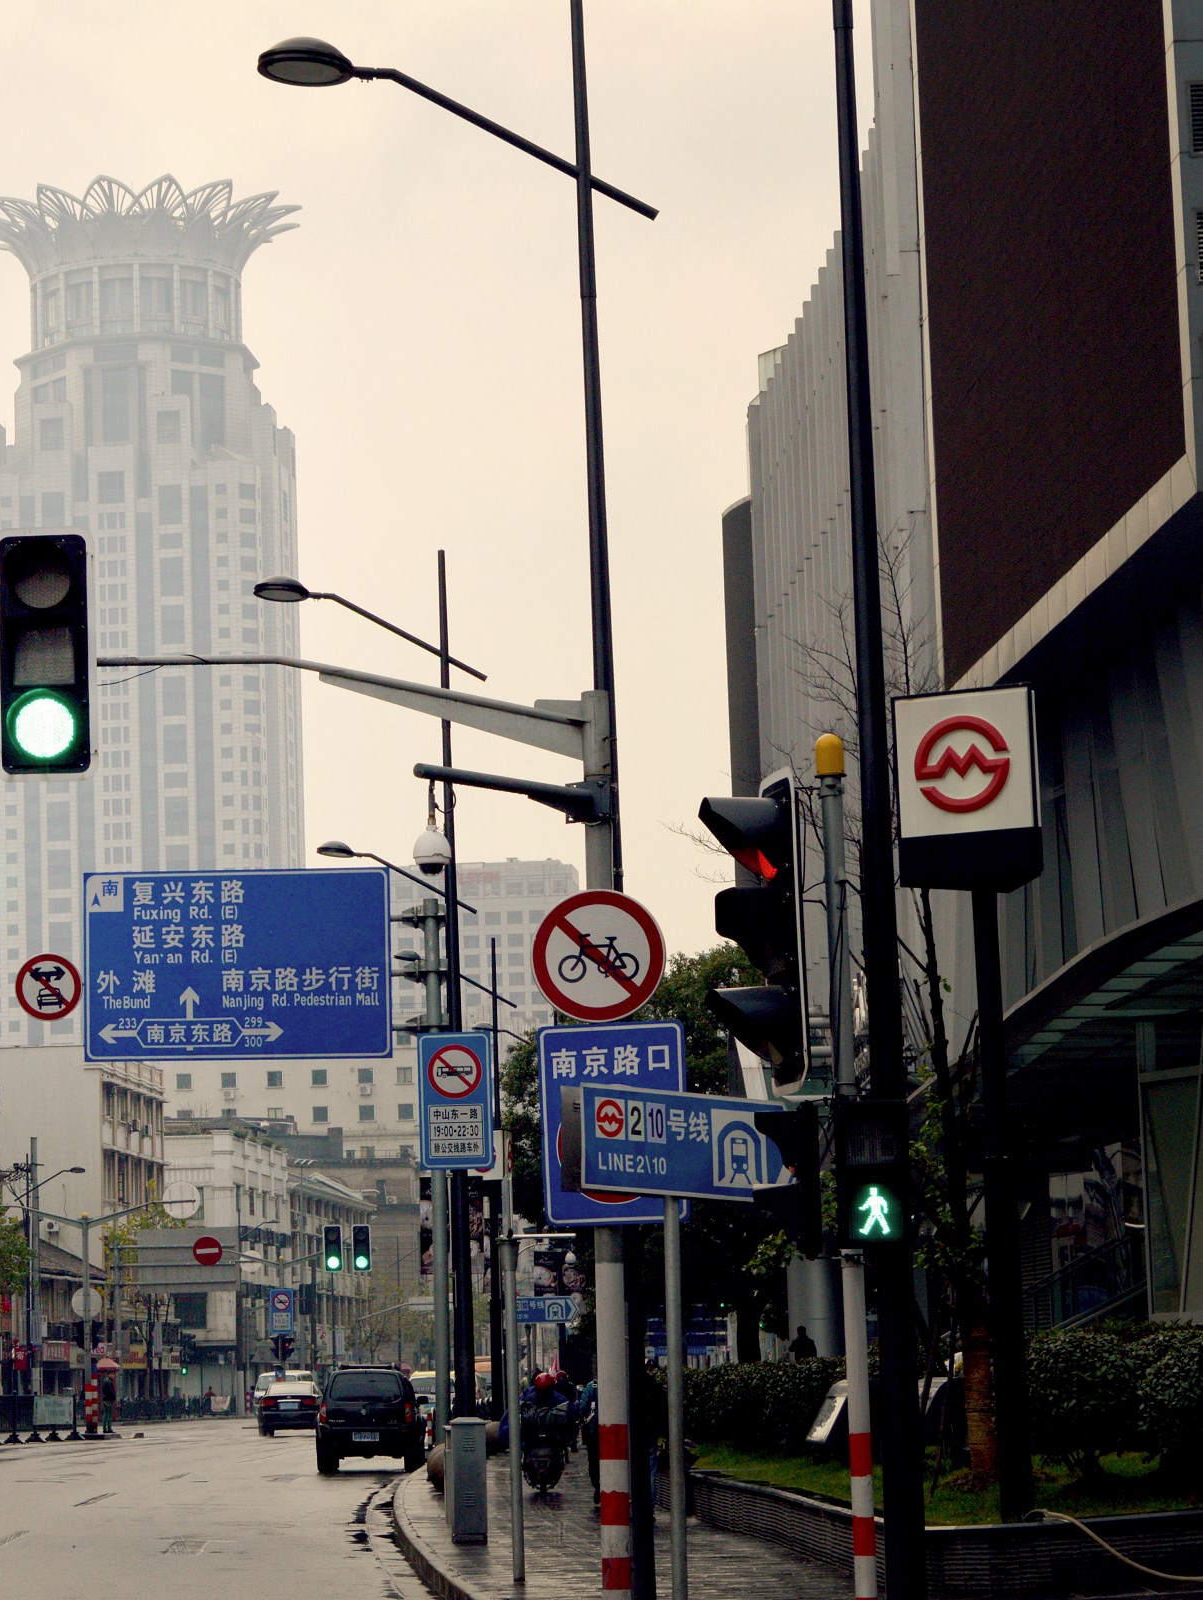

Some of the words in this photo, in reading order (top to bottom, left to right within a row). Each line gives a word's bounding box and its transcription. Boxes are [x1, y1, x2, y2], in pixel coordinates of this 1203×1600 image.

[101, 880, 118, 896] 南
[132, 880, 245, 906] 复兴东路
[133, 906, 181, 923] Fuxing
[189, 906, 212, 920] Rd.
[221, 905, 238, 920] (E)
[132, 924, 245, 949] 延安东路
[191, 951, 213, 964] Rd.
[221, 951, 238, 965] (E)
[96, 969, 156, 994] 外滩
[221, 966, 380, 992] 南京路步行街
[222, 994, 264, 1011] Nanjing
[271, 994, 290, 1008] Rd.
[294, 993, 352, 1007] Pedestrian
[356, 992, 380, 1006] Mall
[118, 1018, 137, 1030] 233
[244, 1016, 263, 1028] 299
[147, 1023, 233, 1044] 南京东路
[244, 1036, 263, 1048] 300
[551, 1044, 671, 1079] 南京路口
[433, 1108, 478, 1121] 中山东一路
[433, 1125, 479, 1137] 19:00-22:30
[434, 1142, 480, 1154] 除公交线路车外
[598, 1151, 634, 1173] LINE
